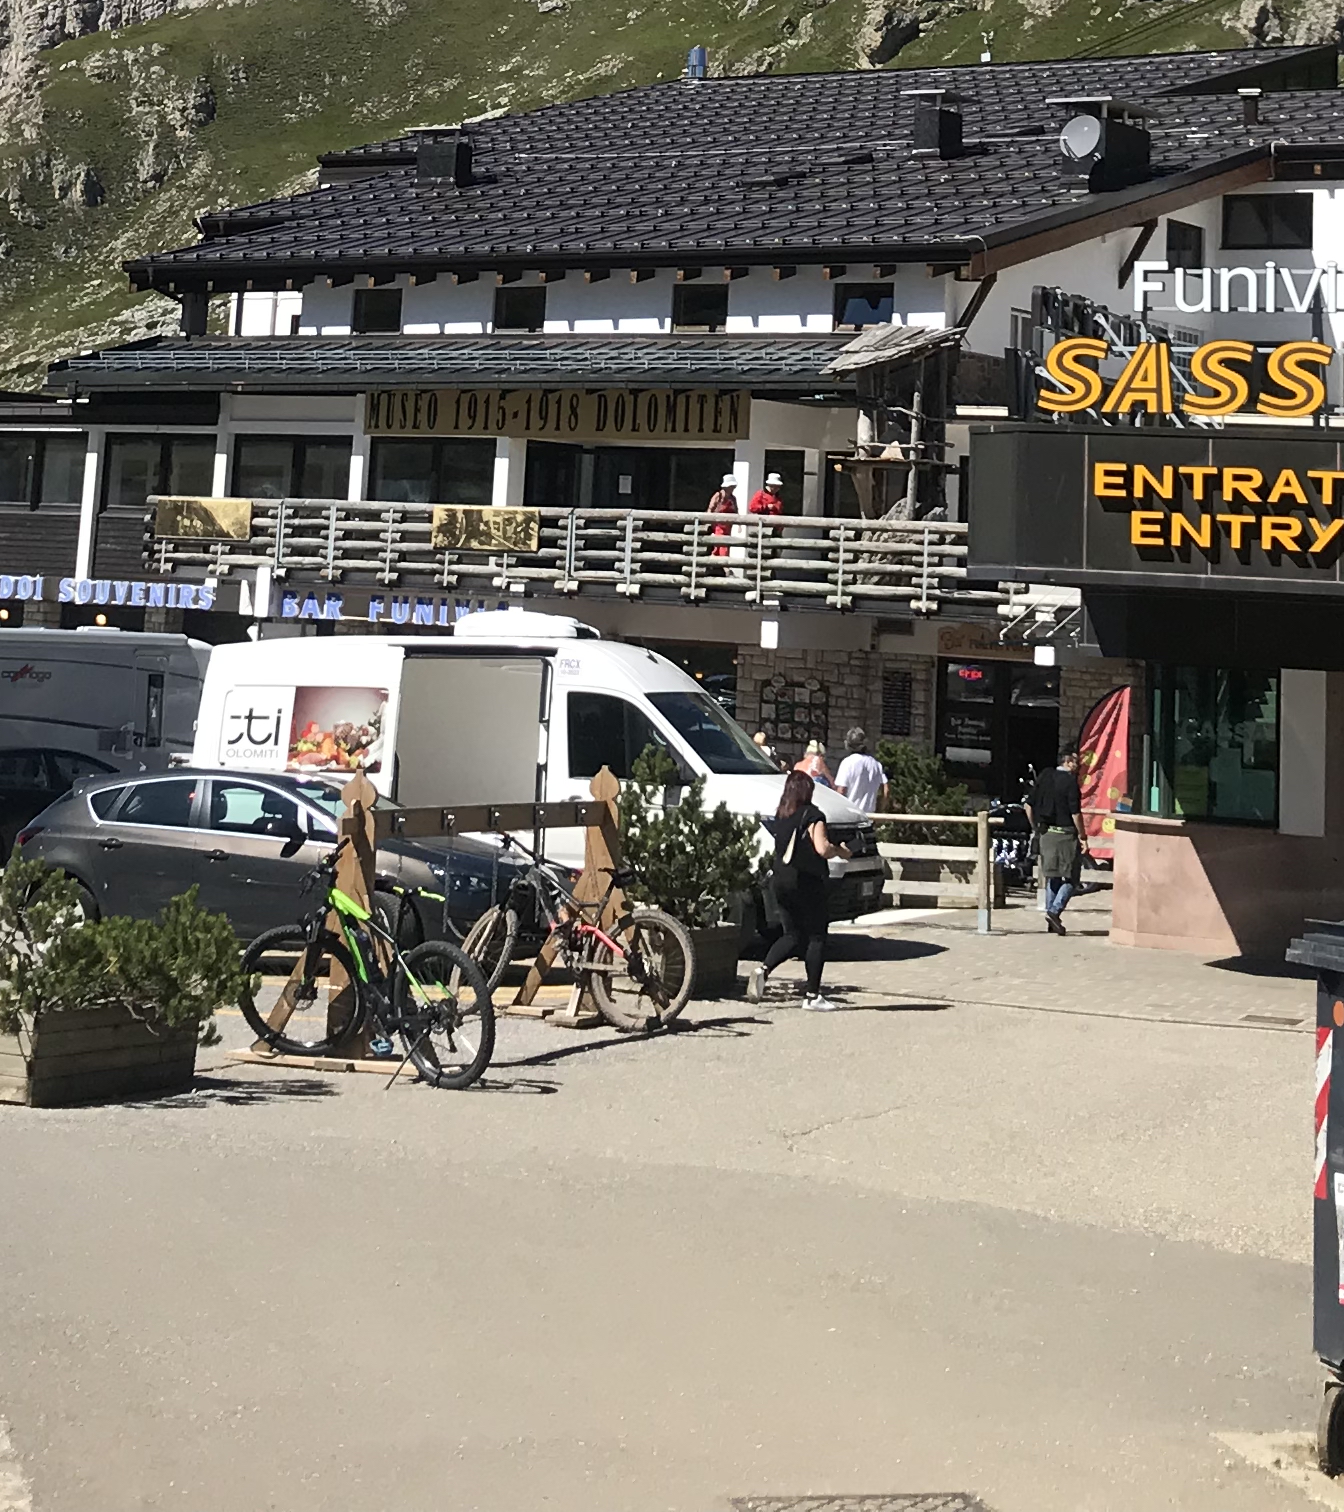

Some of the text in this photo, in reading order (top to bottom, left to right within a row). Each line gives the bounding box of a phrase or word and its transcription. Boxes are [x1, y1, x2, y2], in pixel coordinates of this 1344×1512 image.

[1037, 337, 1334, 418] SASS
[368, 392, 741, 434] MUSEO 1915-1918 DOLOMITEN
[57, 577, 217, 611] SOUVENIRS
[282, 590, 344, 620] BAR
